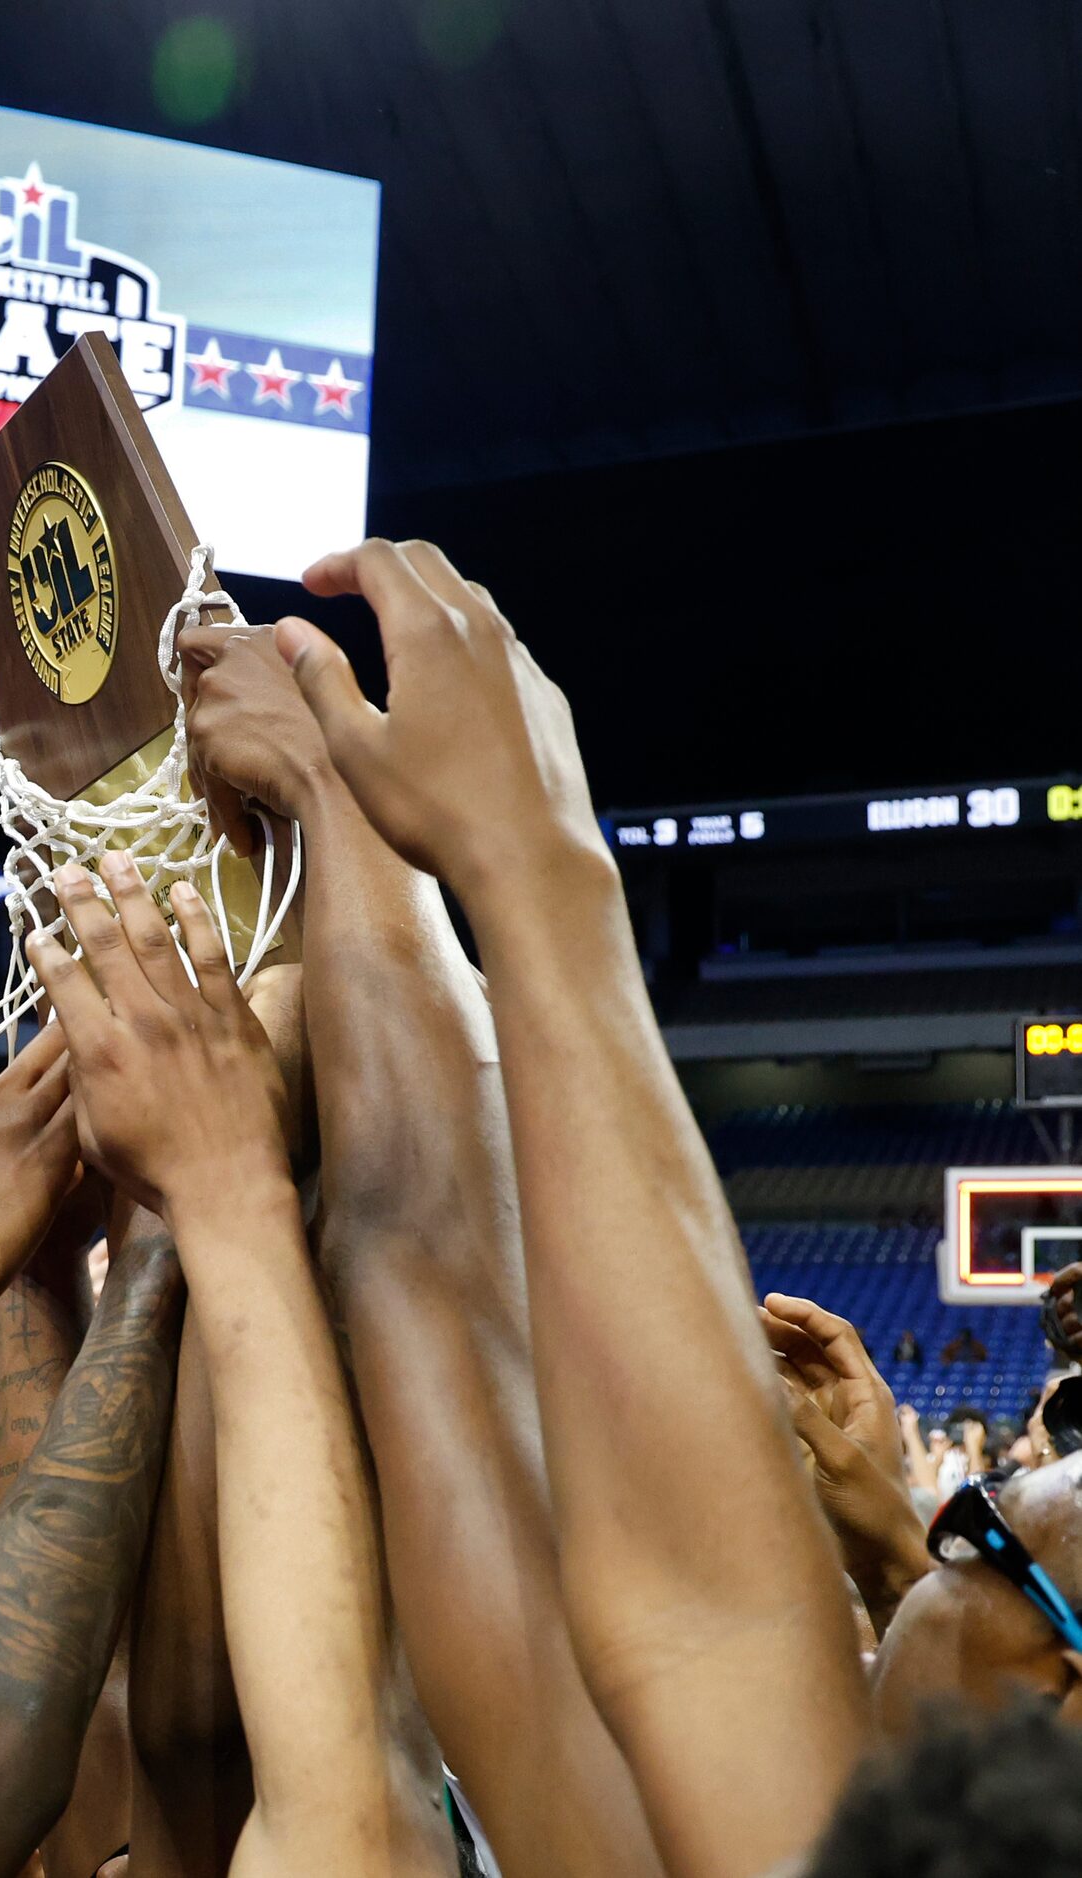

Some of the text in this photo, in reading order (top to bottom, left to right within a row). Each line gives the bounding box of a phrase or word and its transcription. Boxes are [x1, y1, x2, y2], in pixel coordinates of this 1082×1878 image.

[9, 469, 114, 694] UNIVERSITY INTERSCHOLASTIC LEAGUE
[21, 516, 96, 636] UIL
[52, 607, 92, 659] STATE
[967, 787, 1019, 828] 30
